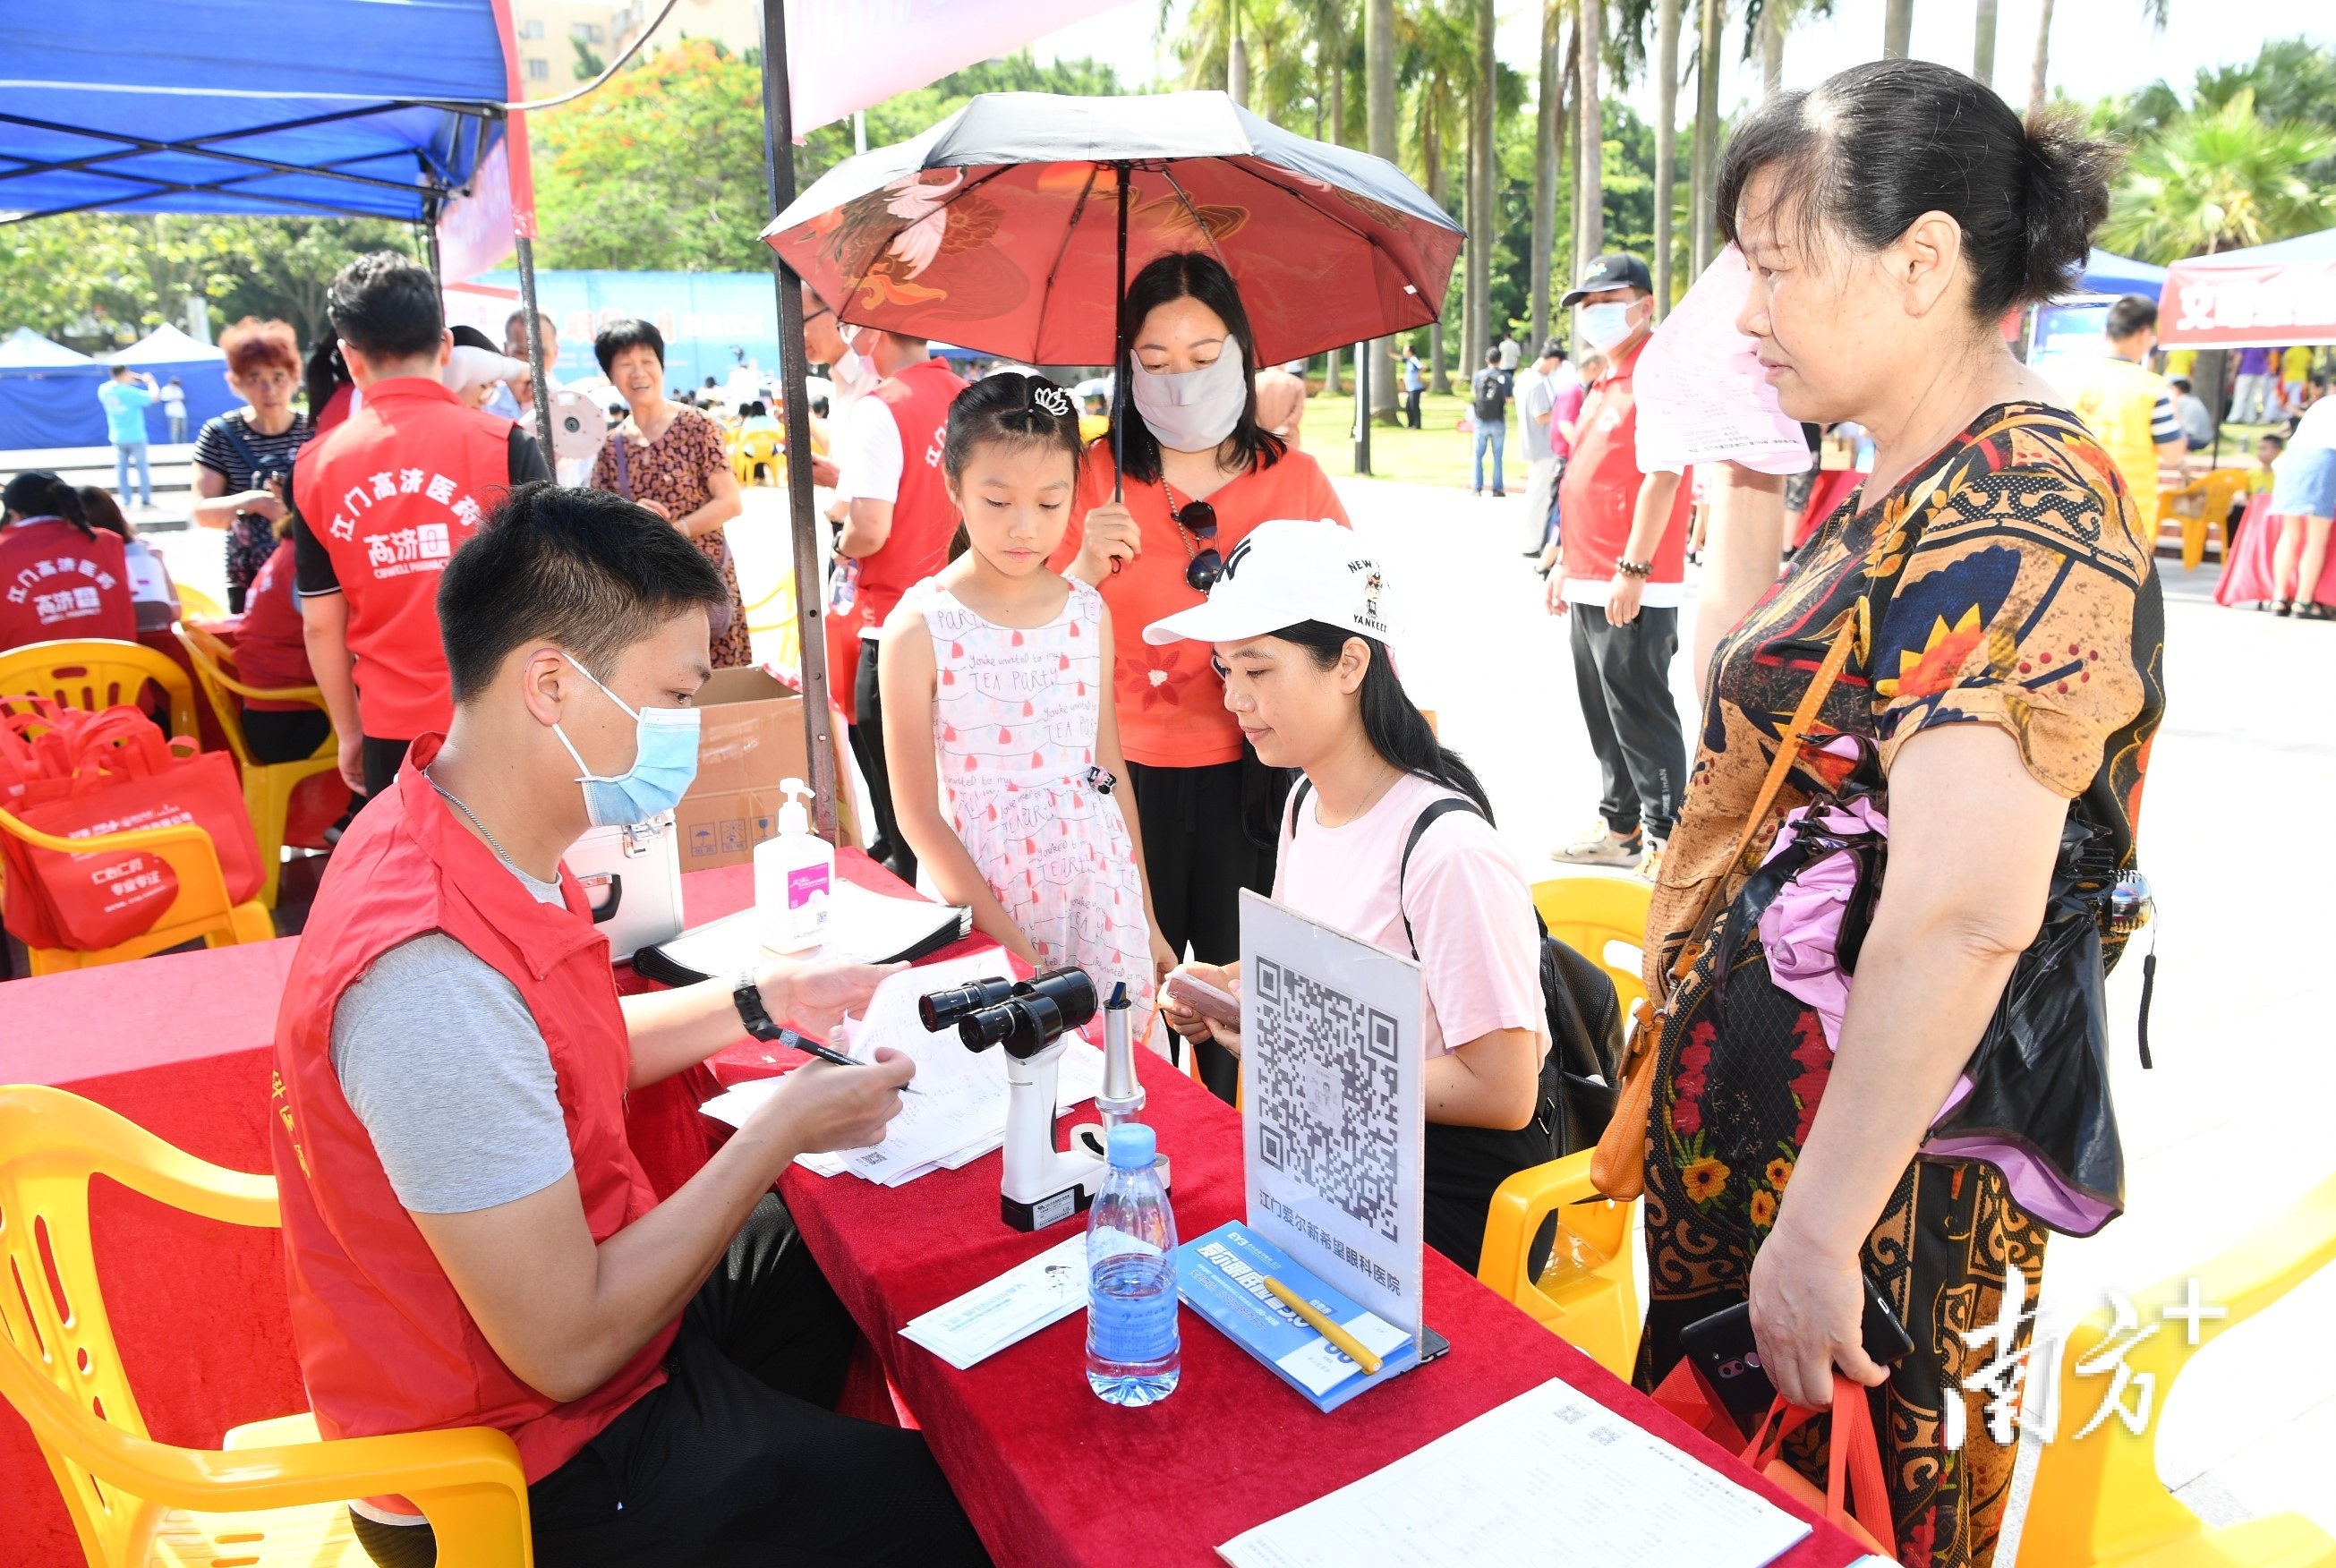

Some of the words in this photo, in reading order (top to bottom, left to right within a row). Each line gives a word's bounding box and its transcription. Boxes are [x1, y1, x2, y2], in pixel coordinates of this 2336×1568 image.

[329, 467, 482, 541] 江门高济医药
[363, 528, 418, 567] 高济
[1348, 559, 1373, 574] NEW
[968, 672, 1002, 690] TEA
[1259, 1189, 1402, 1297] 江门爱尔新希望眼科医院
